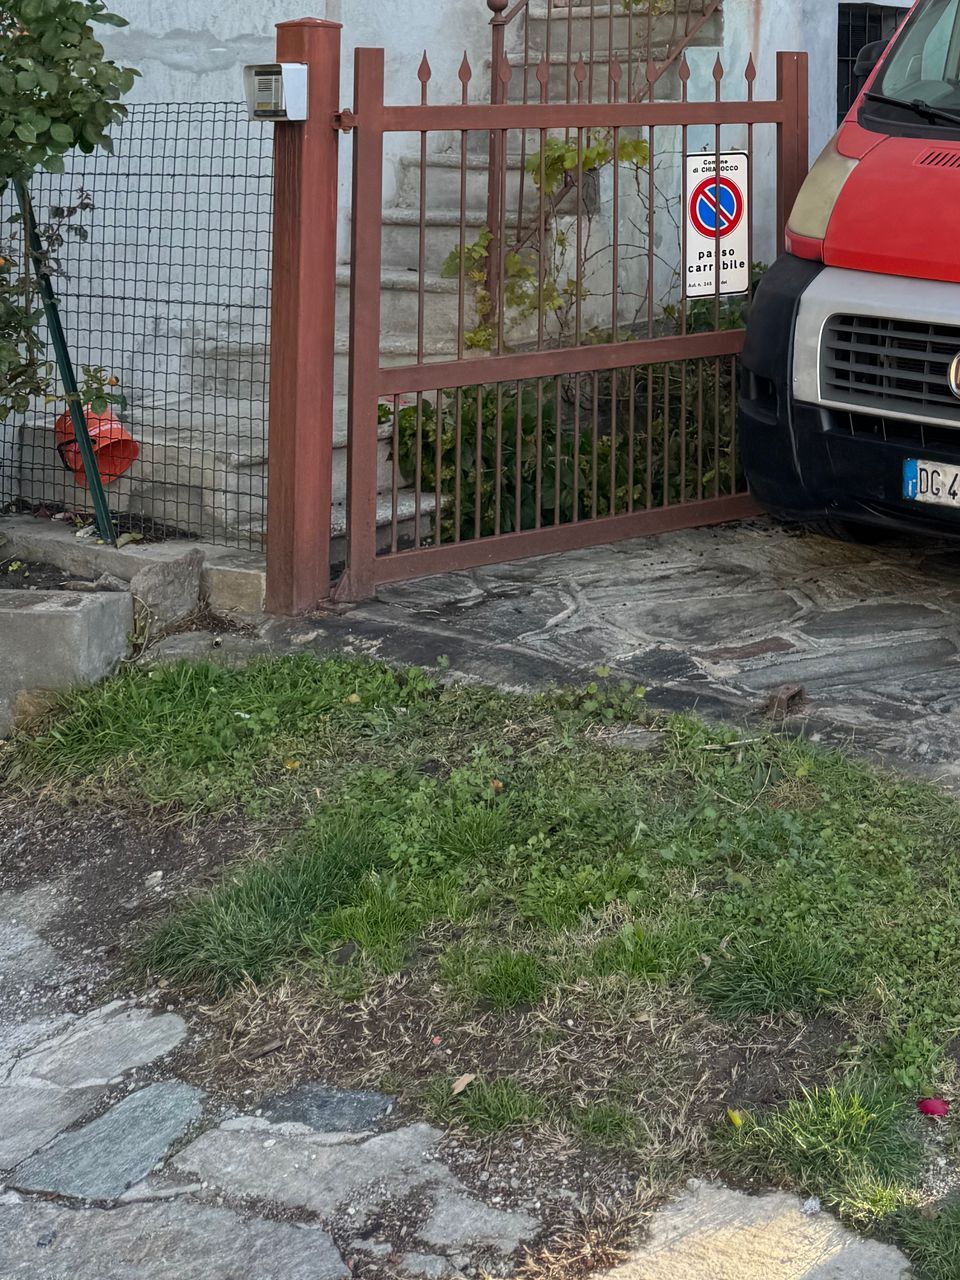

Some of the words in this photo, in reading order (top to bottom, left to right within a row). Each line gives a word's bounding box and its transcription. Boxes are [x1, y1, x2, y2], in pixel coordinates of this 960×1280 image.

[701, 165, 739, 173] CHIAOCCO
[698, 249, 735, 260] paso
[688, 259, 745, 273] carrbile
